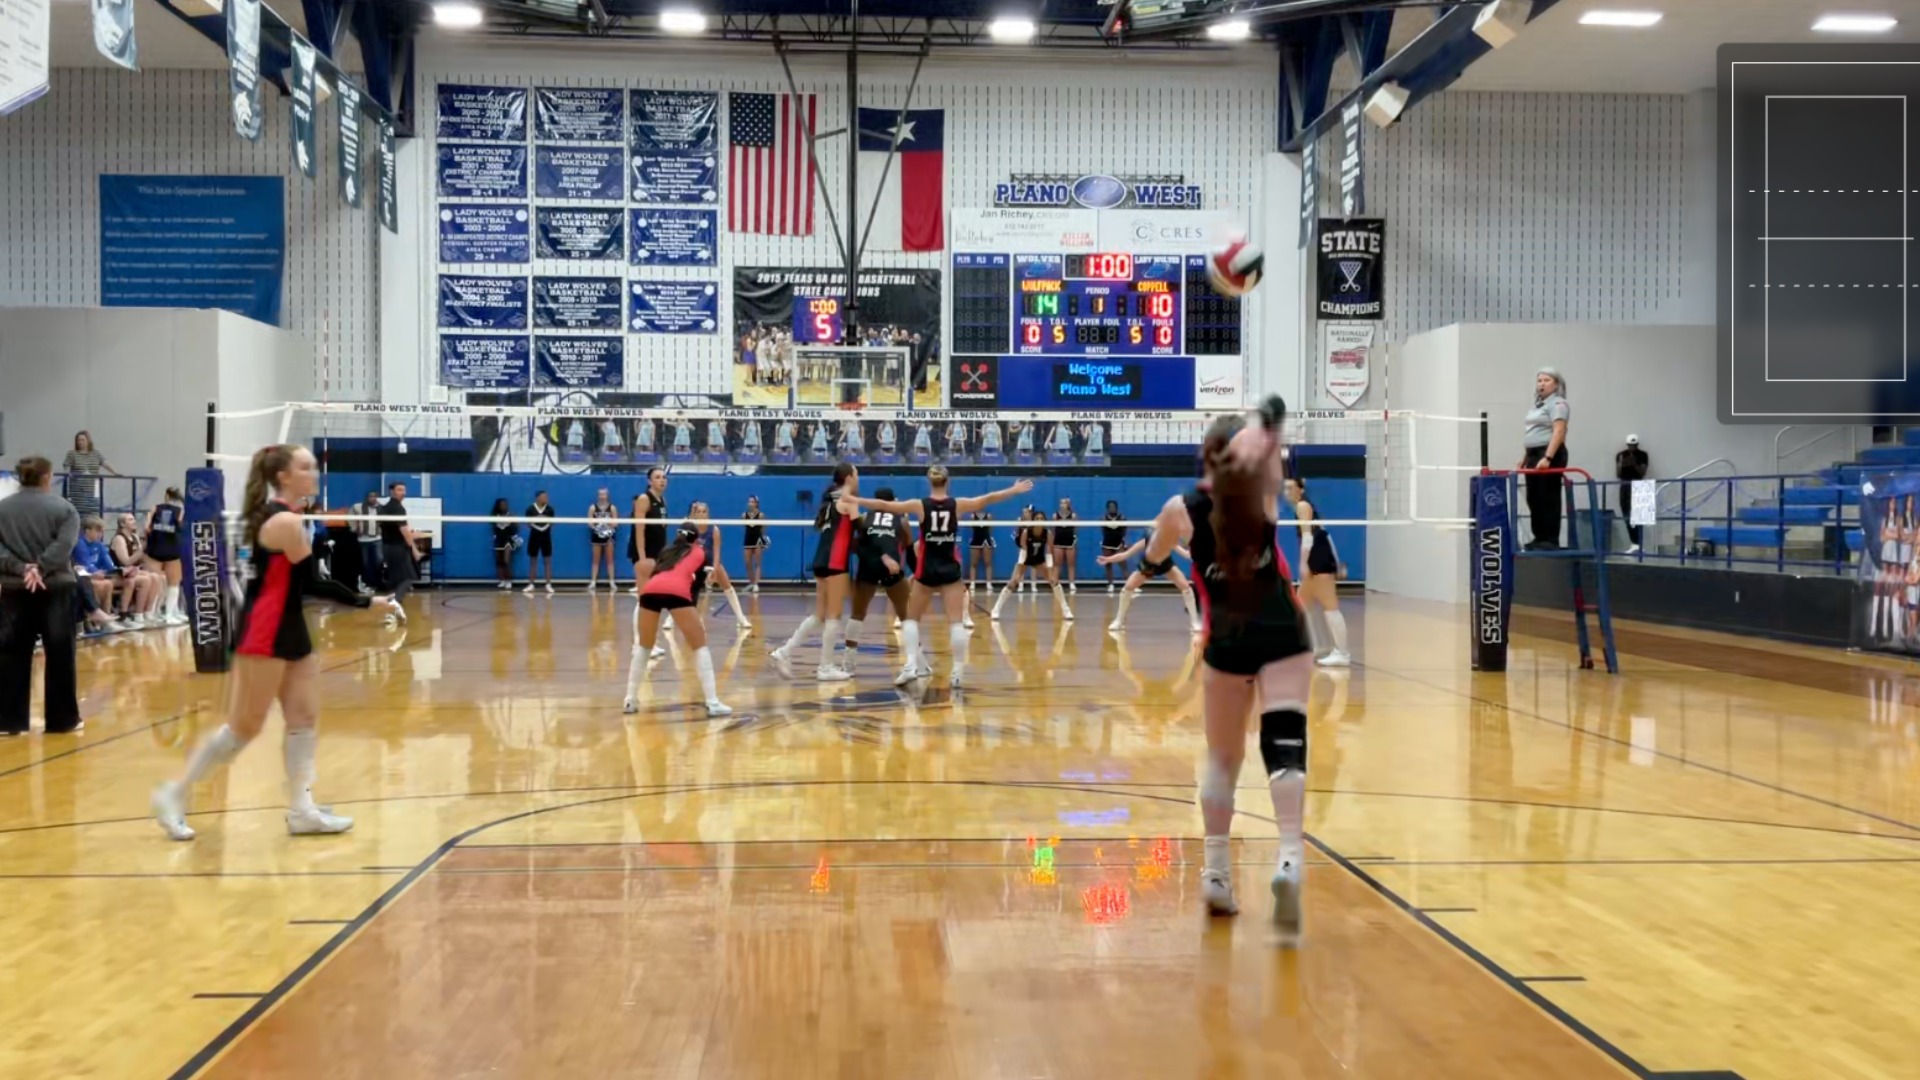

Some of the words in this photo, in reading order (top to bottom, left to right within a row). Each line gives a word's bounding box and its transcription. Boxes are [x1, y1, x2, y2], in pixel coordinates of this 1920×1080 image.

[454, 155, 510, 163] BASKETBALL
[551, 159, 608, 167] BASKETBALL
[996, 183, 1069, 204] PLANO
[1135, 184, 1201, 205] WEST
[981, 209, 998, 219] Jan
[1160, 227, 1203, 239] CRES
[1321, 230, 1380, 253] STATE
[1016, 255, 1061, 263] WOLVES
[1089, 255, 1130, 278] 1:00
[757, 273, 781, 284] 2015
[783, 273, 812, 284] TEXAS
[830, 274, 849, 284] BO
[858, 274, 916, 285] BASKETBALL
[455, 286, 511, 294] BASKETBALL
[793, 286, 821, 297] STATE
[1037, 295, 1058, 315] 14
[1152, 294, 1173, 317] 10
[1321, 301, 1380, 315] CHAMPIONS
[815, 314, 832, 340] 5
[1028, 325, 1041, 343] 0
[1052, 325, 1065, 343] 5
[1130, 326, 1142, 344] 5
[1160, 326, 1172, 344] 0
[1085, 346, 1109, 354] MATCH
[1069, 363, 1123, 375] Welcome
[1090, 375, 1105, 385] To
[1060, 384, 1097, 396] Plano
[1101, 383, 1132, 396] West
[1200, 385, 1235, 395] verizon
[354, 404, 385, 413] PLANO
[388, 405, 417, 413] WEST
[538, 407, 569, 416] PLANO
[572, 407, 600, 416] WEST
[604, 407, 644, 416] WOLVES
[718, 410, 750, 418] PLANO
[752, 410, 780, 418] WEST
[783, 410, 822, 418] WOLVES
[896, 411, 926, 419] PLANO
[929, 411, 957, 419] WEST
[960, 411, 998, 419] WOLVES
[1307, 411, 1346, 419] WOLVES
[873, 512, 894, 527] 12
[930, 511, 950, 532] 17
[1032, 542, 1042, 556] 7
[191, 521, 222, 645] WOLVES
[1480, 527, 1502, 644] WOLVES
